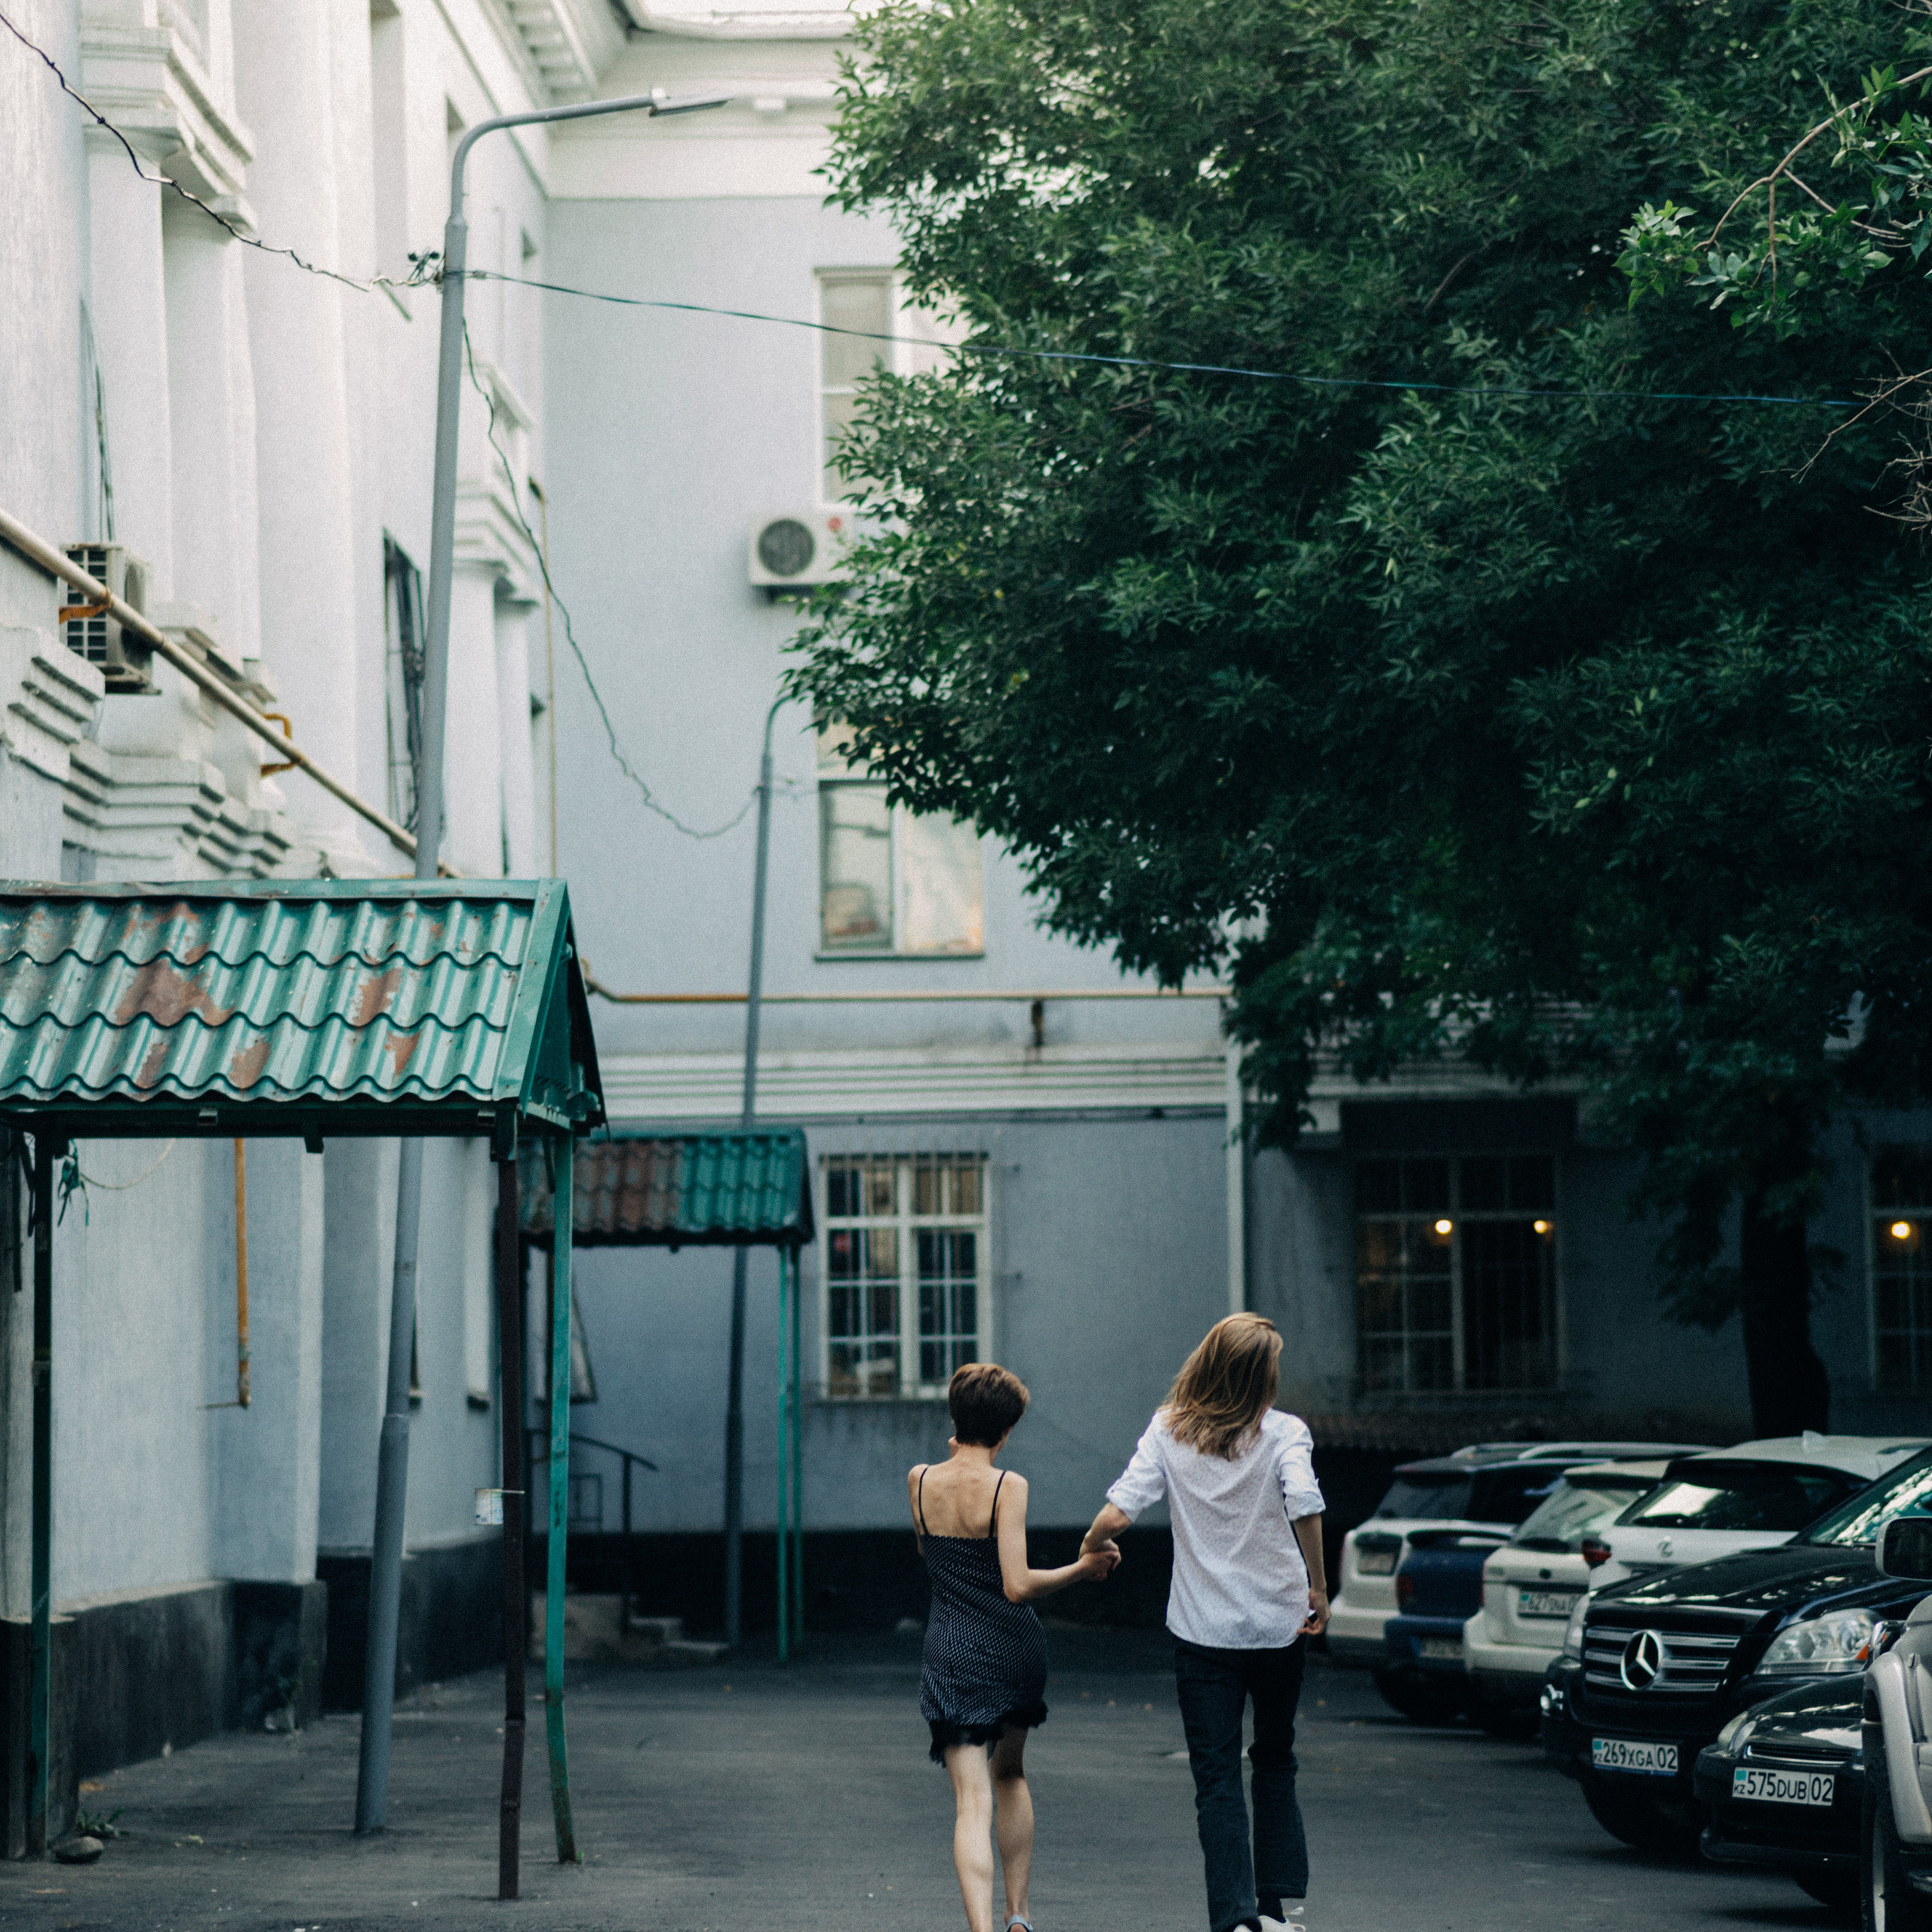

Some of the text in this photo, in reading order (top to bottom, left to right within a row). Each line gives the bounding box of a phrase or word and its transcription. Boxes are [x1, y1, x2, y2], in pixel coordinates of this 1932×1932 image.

[1603, 1742, 1677, 1770] 269XGA 02
[1734, 1784, 1746, 1795] KZ
[1747, 1771, 1833, 1802] 575DUB 02
